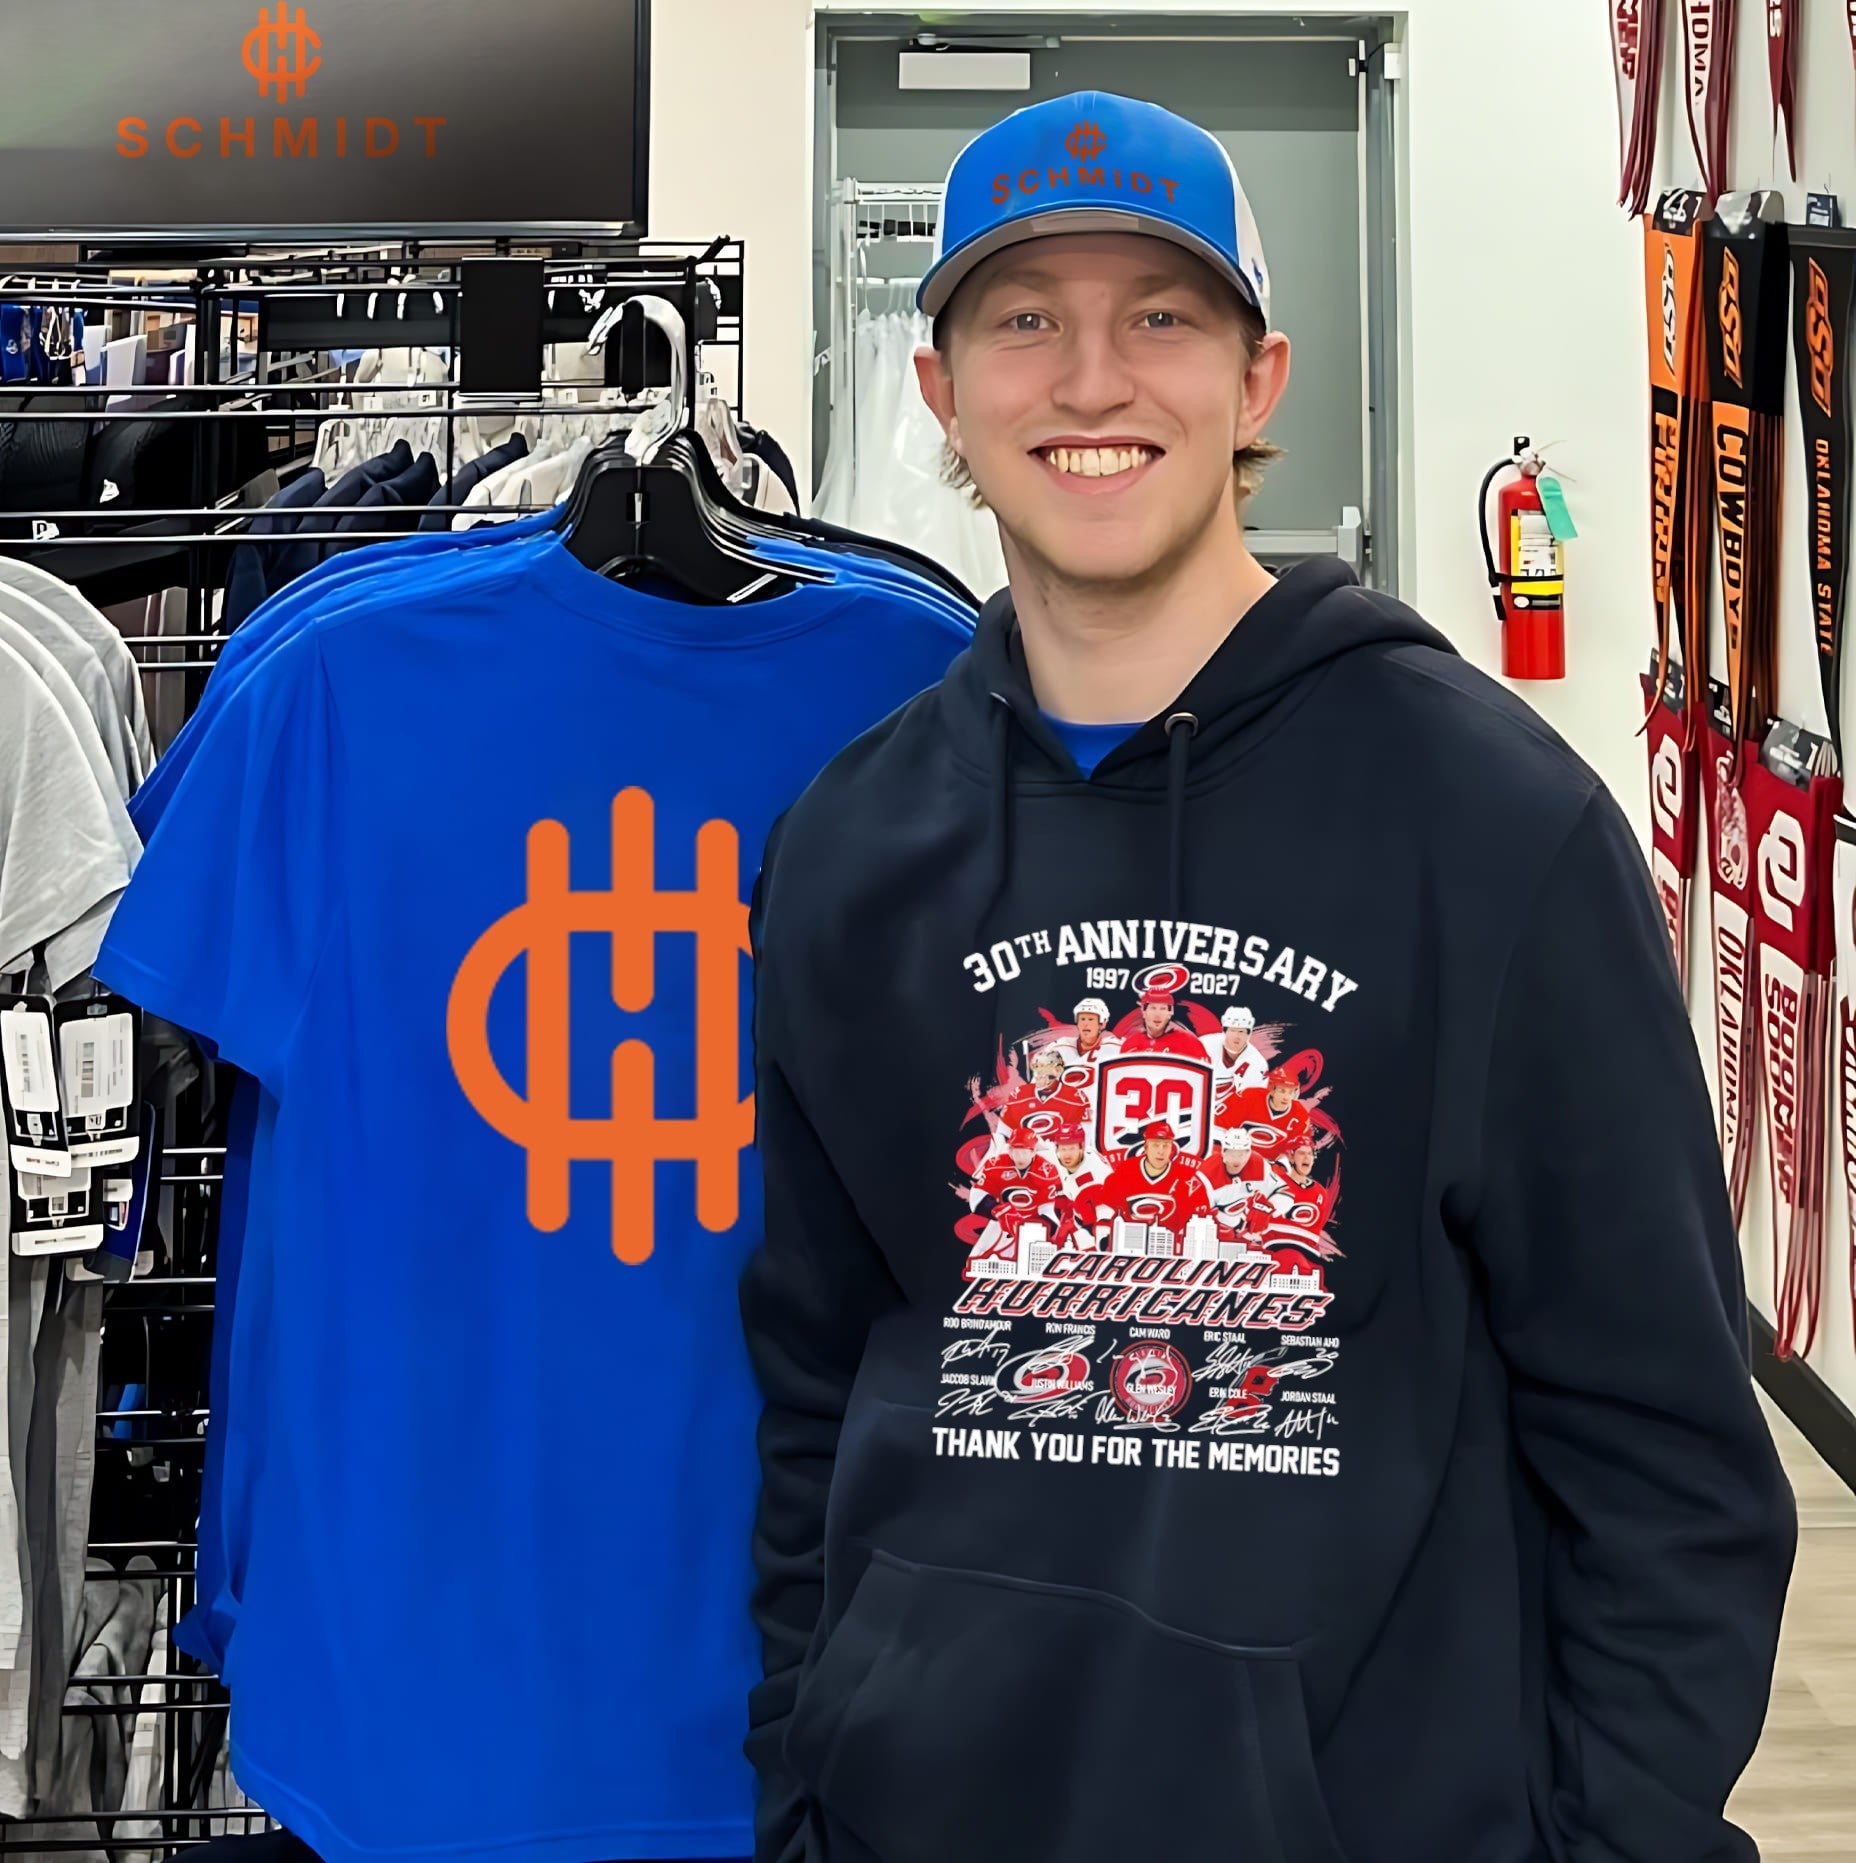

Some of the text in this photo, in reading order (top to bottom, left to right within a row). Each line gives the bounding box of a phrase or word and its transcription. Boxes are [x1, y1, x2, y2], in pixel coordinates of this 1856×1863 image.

[115, 116, 449, 159] SCHMIDT
[991, 166, 1180, 204] SCHMIDT
[1814, 438, 1833, 656] OKLAHOMA STATE
[962, 918, 1359, 1013] 30TH ANNIVERSARY
[1086, 966, 1241, 996] 1997 2027
[1718, 927, 1744, 1143] OKLAHOMA
[1042, 1252, 1280, 1289] CAROLINA
[953, 1278, 1335, 1330] HURRICANES
[1045, 1323, 1096, 1336] RON FRANCIS
[1129, 1327, 1171, 1340] CAM WARD
[1203, 1331, 1247, 1344] ERIC STAAL
[1281, 1334, 1322, 1347] SEBASTIAN
[1280, 1391, 1336, 1404] JORDAN STAAL
[932, 1427, 1341, 1477] THANK YOU FOR THE MEMORIES
